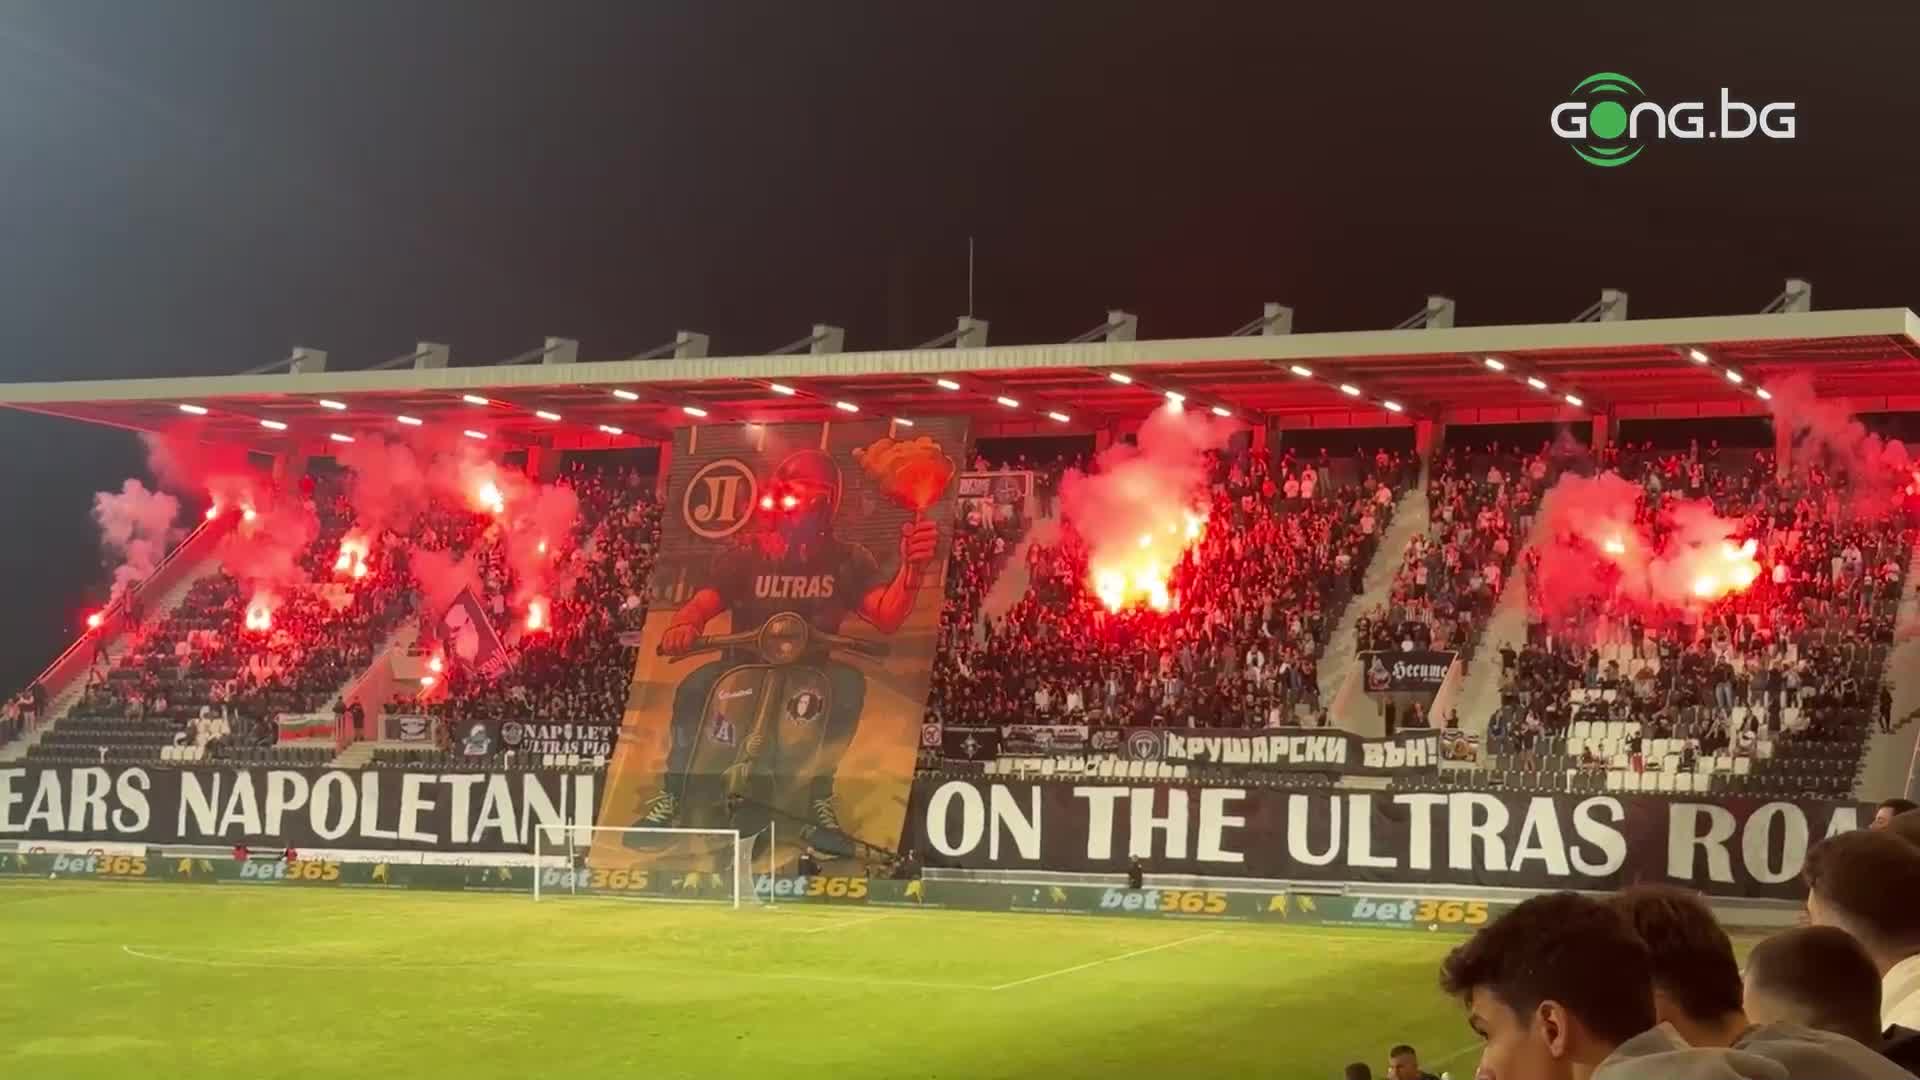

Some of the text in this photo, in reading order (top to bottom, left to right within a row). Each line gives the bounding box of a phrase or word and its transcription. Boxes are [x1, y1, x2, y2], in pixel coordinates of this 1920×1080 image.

[755, 574, 835, 599] ULTRAS
[523, 723, 621, 741] NAPOLET
[1168, 732, 1347, 764] КРУШАРСКИ
[0, 767, 595, 846] EARS NAPOLETANI
[926, 781, 1041, 861] ON
[1073, 787, 1245, 863] THE
[1287, 791, 1627, 877] ULTRAS
[53, 854, 147, 875] bet365
[240, 860, 340, 880] bet365
[542, 867, 648, 889] bet365
[756, 875, 868, 897] bet365
[1100, 888, 1227, 913] bet365
[1351, 898, 1489, 924] bet365
